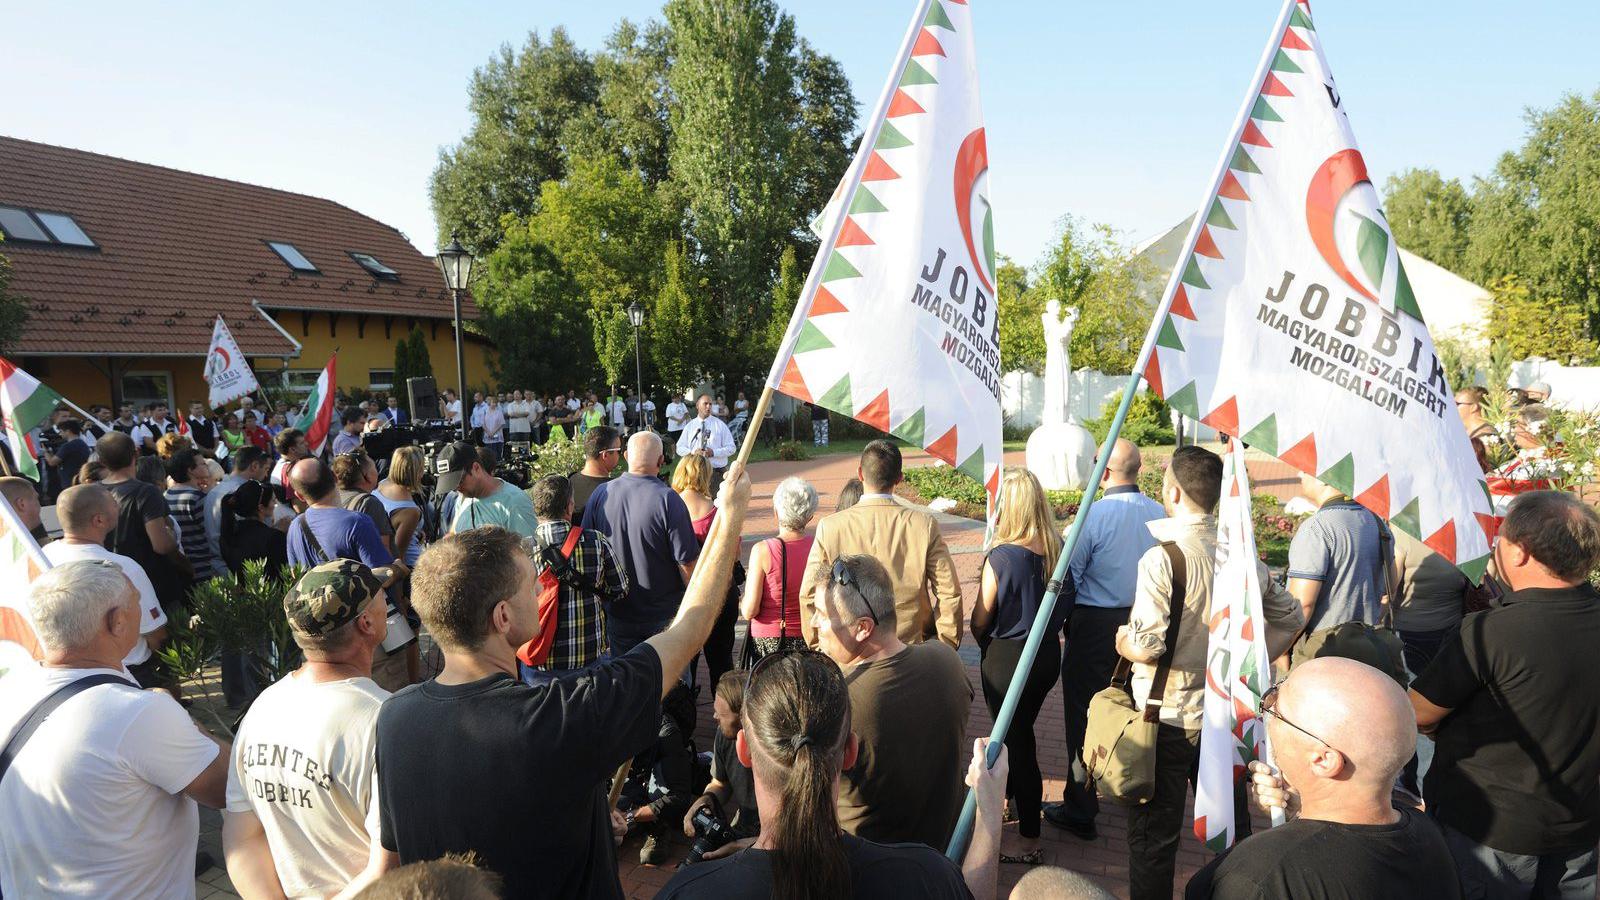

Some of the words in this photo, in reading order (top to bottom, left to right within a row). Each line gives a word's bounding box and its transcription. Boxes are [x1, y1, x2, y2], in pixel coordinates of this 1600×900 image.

[1256, 303, 1447, 418] MAGYARORSZÁGÉRT
[1265, 270, 1447, 397] JOBBIK
[1290, 346, 1408, 419] MOZGALOM
[254, 778, 313, 808] OBBIK
